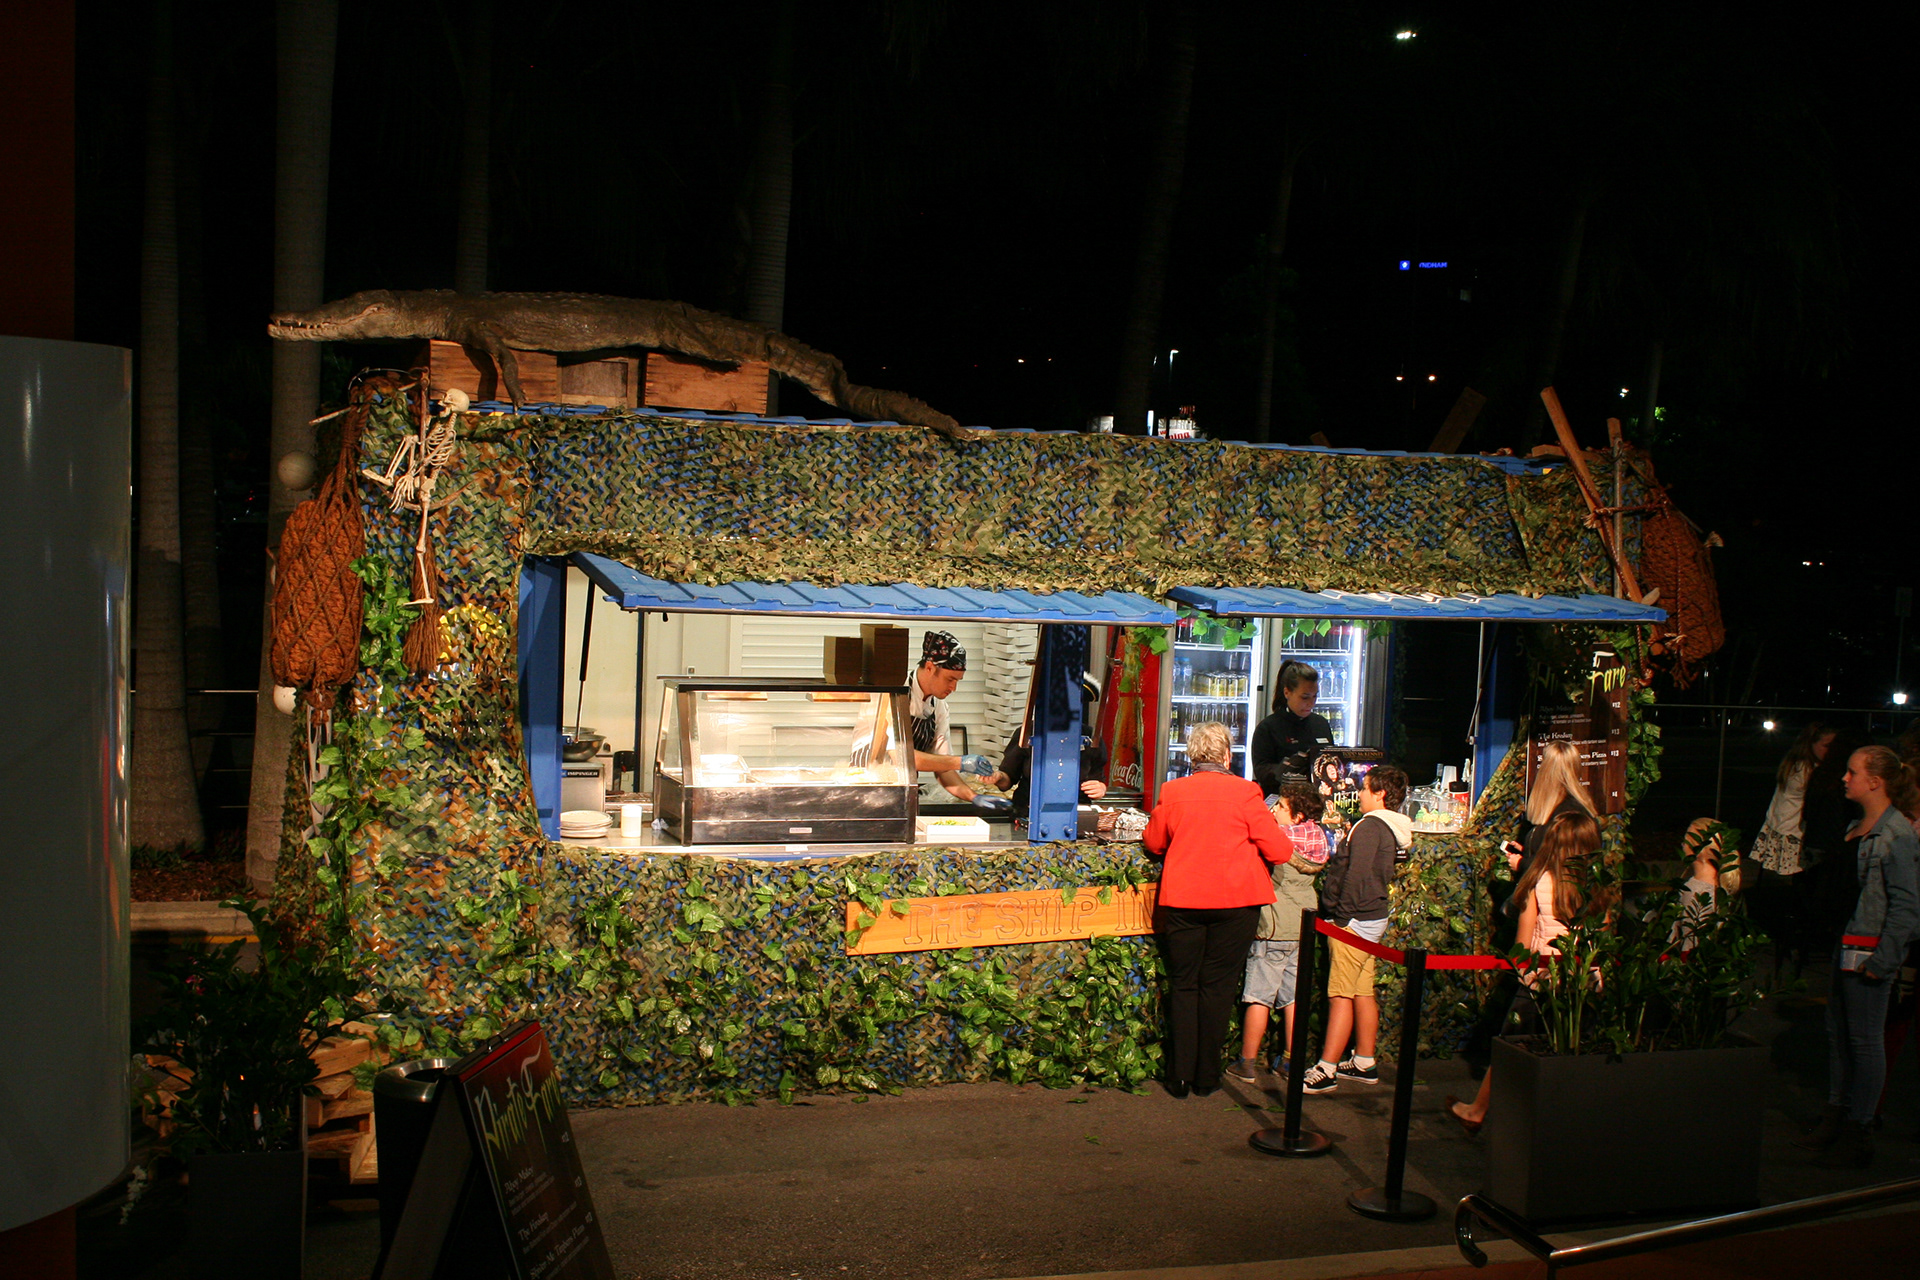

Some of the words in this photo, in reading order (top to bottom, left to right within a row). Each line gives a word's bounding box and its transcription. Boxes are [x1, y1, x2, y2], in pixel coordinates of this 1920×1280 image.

[1586, 650, 1627, 706] Fare
[889, 902, 983, 945] THE
[994, 894, 1099, 941] SHIP
[1115, 888, 1158, 932] IN
